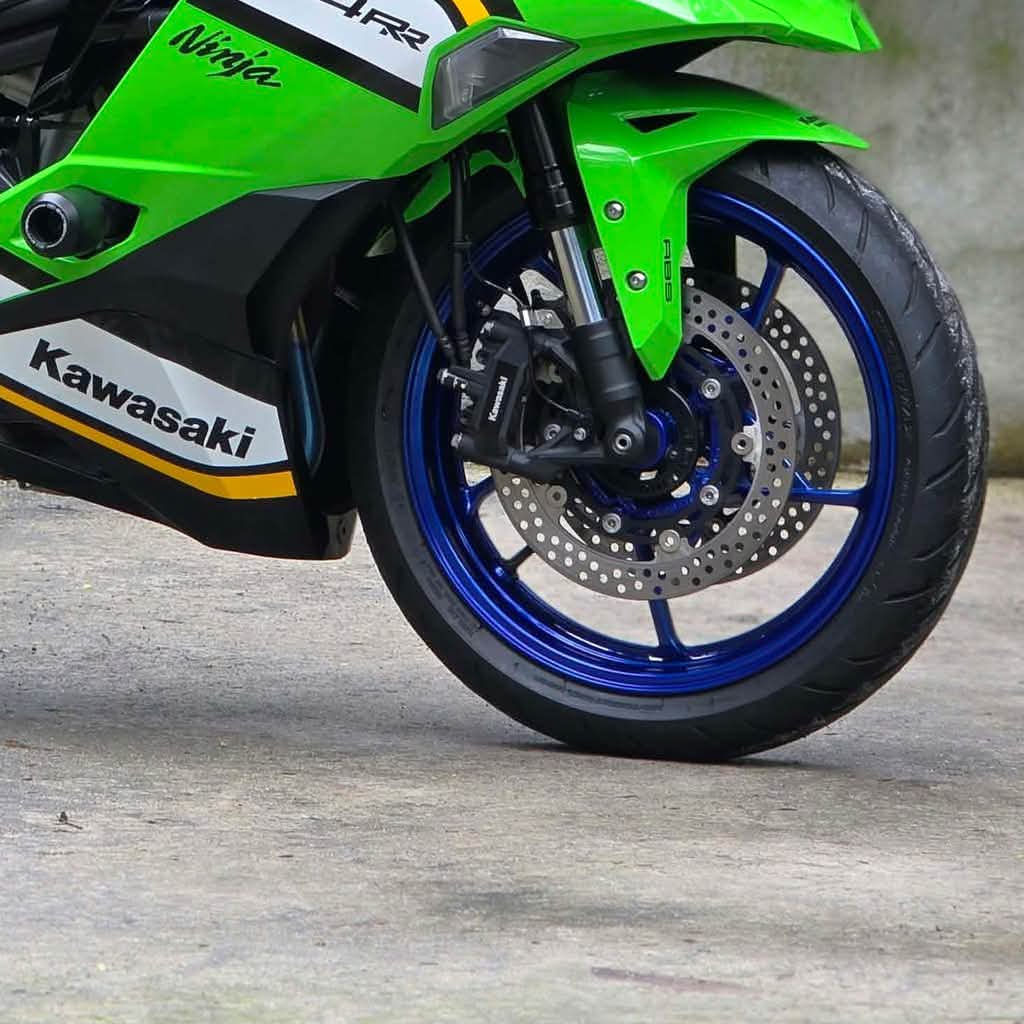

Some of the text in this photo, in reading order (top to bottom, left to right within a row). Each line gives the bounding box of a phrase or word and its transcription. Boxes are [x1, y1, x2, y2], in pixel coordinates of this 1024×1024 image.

[168, 24, 282, 88] Ninja
[662, 238, 673, 302] ABS
[29, 338, 257, 459] Kawasaki
[487, 375, 509, 422] Kawasaki
